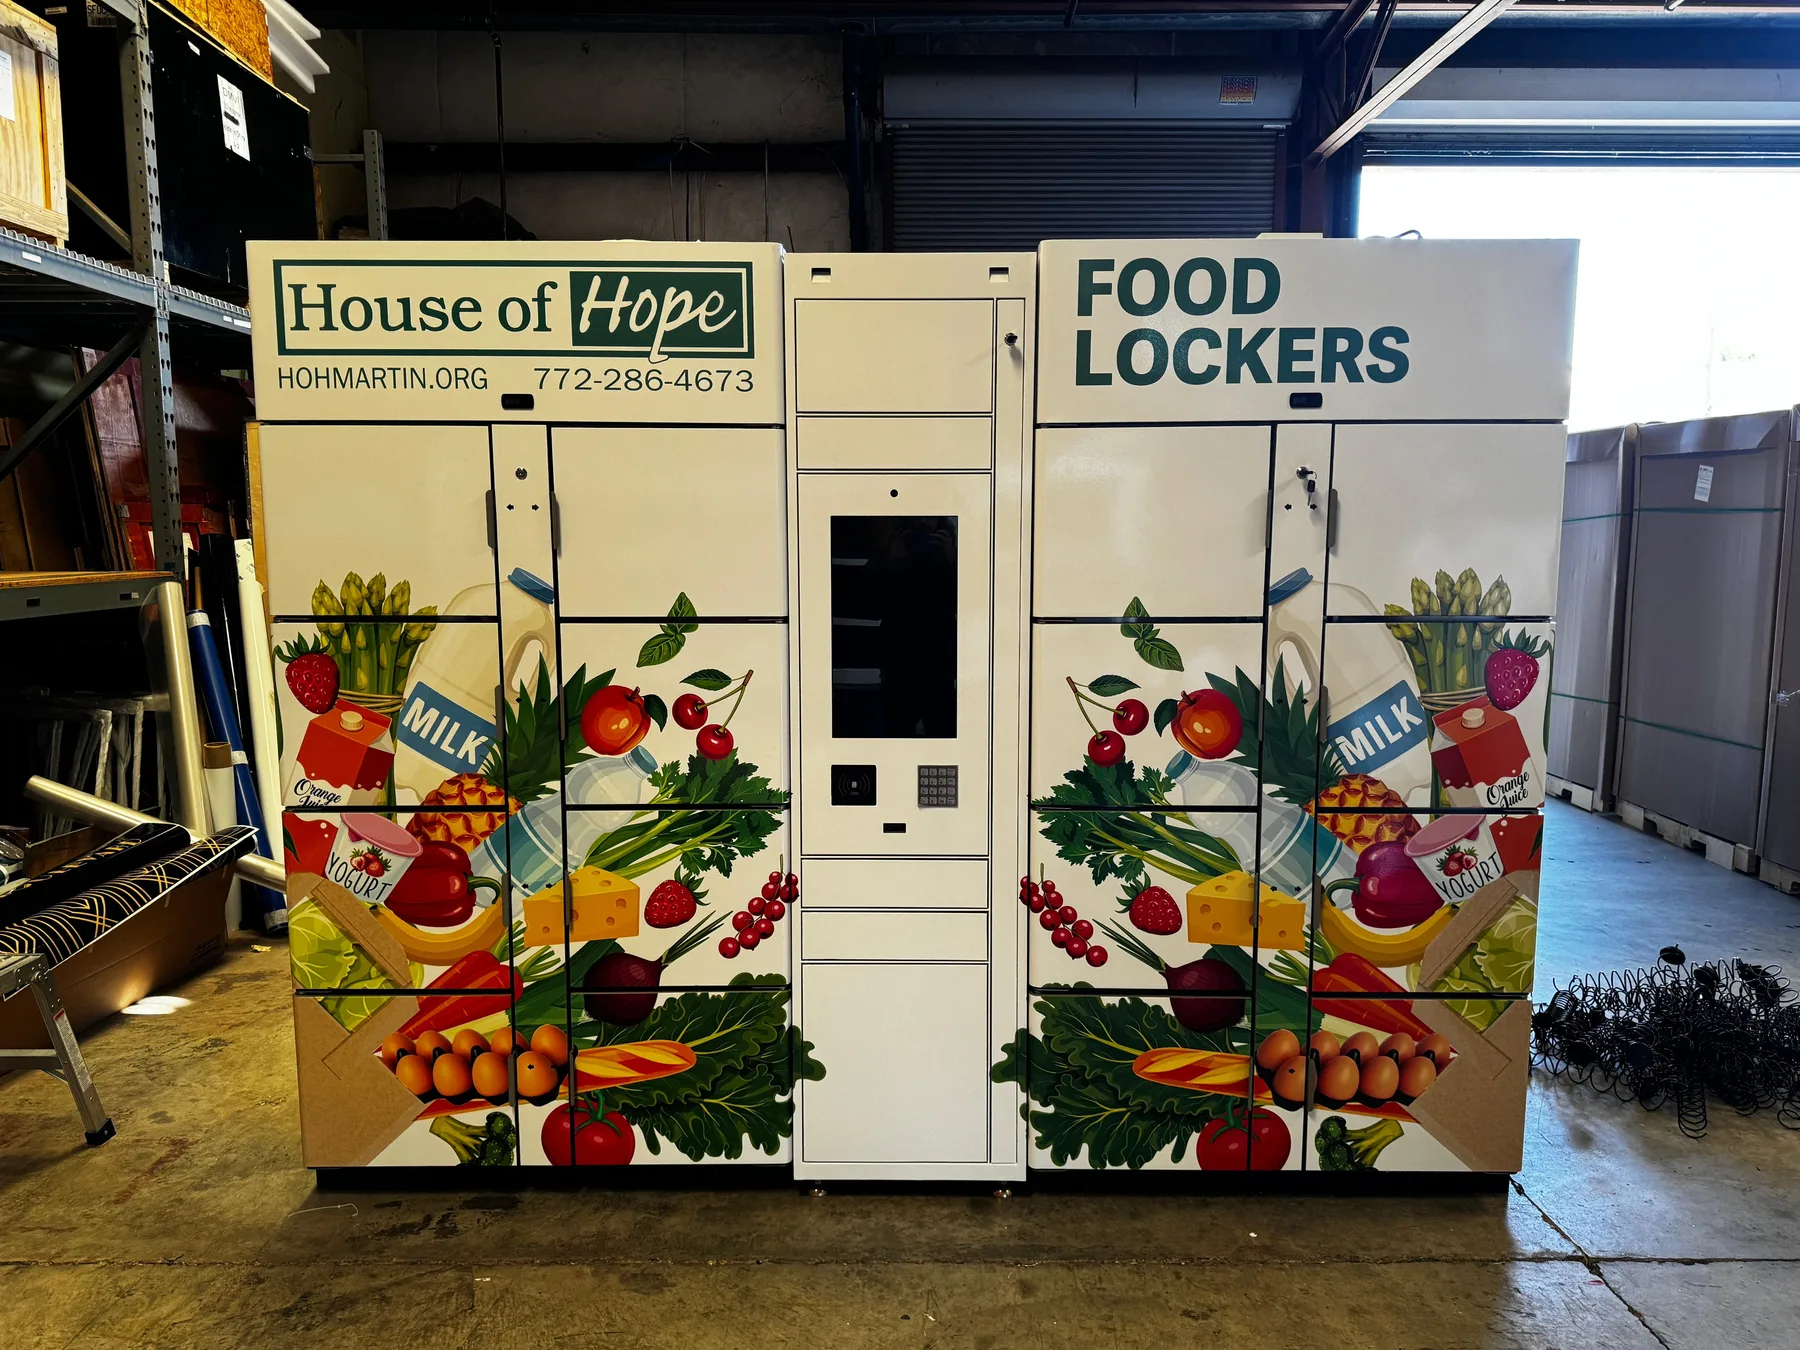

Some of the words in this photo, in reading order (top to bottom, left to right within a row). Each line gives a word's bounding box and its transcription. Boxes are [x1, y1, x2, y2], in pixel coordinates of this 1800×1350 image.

[1077, 257, 1281, 316] FOOD
[287, 283, 483, 332] House
[498, 280, 558, 332] of
[579, 275, 737, 364] Hope
[278, 367, 488, 390] HOHMARTIN.ORG
[534, 367, 754, 392] 772-286-4673
[1075, 326, 1410, 386] LOCKERS
[401, 697, 488, 765] MILK
[1335, 696, 1423, 766] MILK
[293, 778, 342, 805] Orange
[1486, 771, 1529, 805] Orange
[1500, 788, 1528, 818] Juice
[328, 852, 393, 901] YOGURT
[1435, 852, 1502, 900] YOGURT
